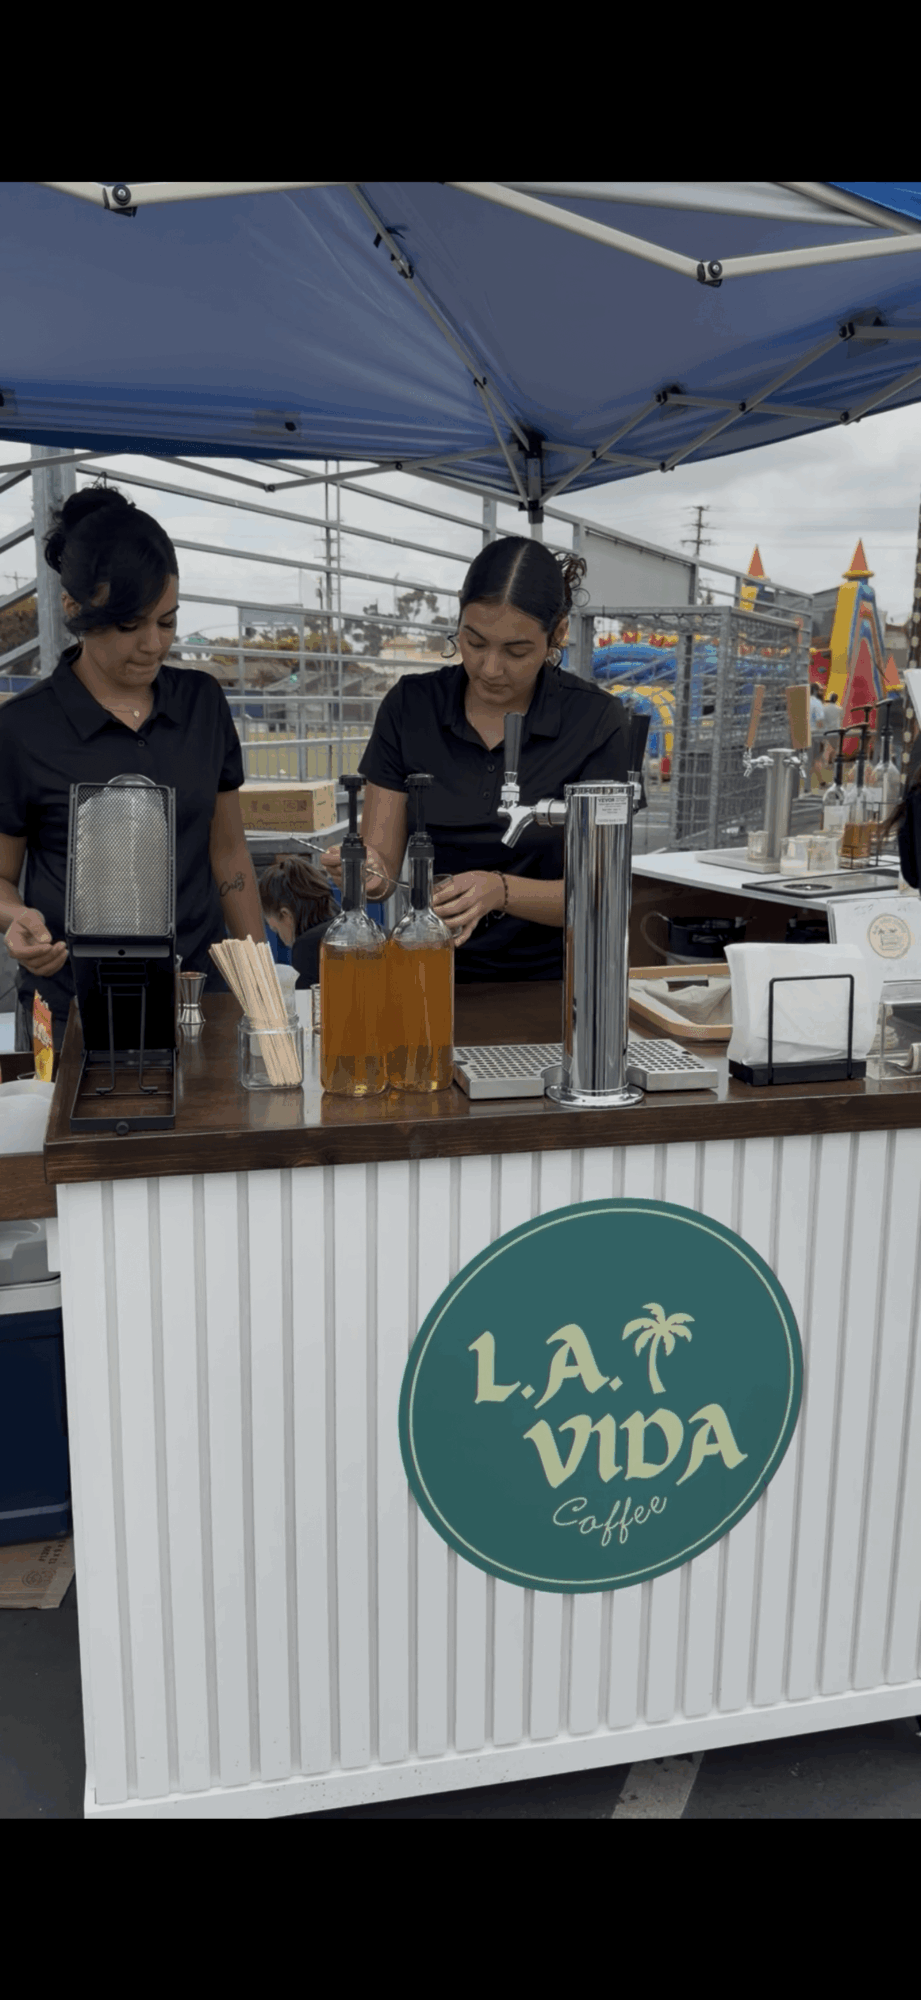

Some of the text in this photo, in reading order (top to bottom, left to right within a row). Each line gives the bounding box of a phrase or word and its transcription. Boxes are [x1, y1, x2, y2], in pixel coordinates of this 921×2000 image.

[468, 1323, 623, 1409] L.A.
[523, 1403, 748, 1488] VIDA
[552, 1496, 667, 1546] Coffee
